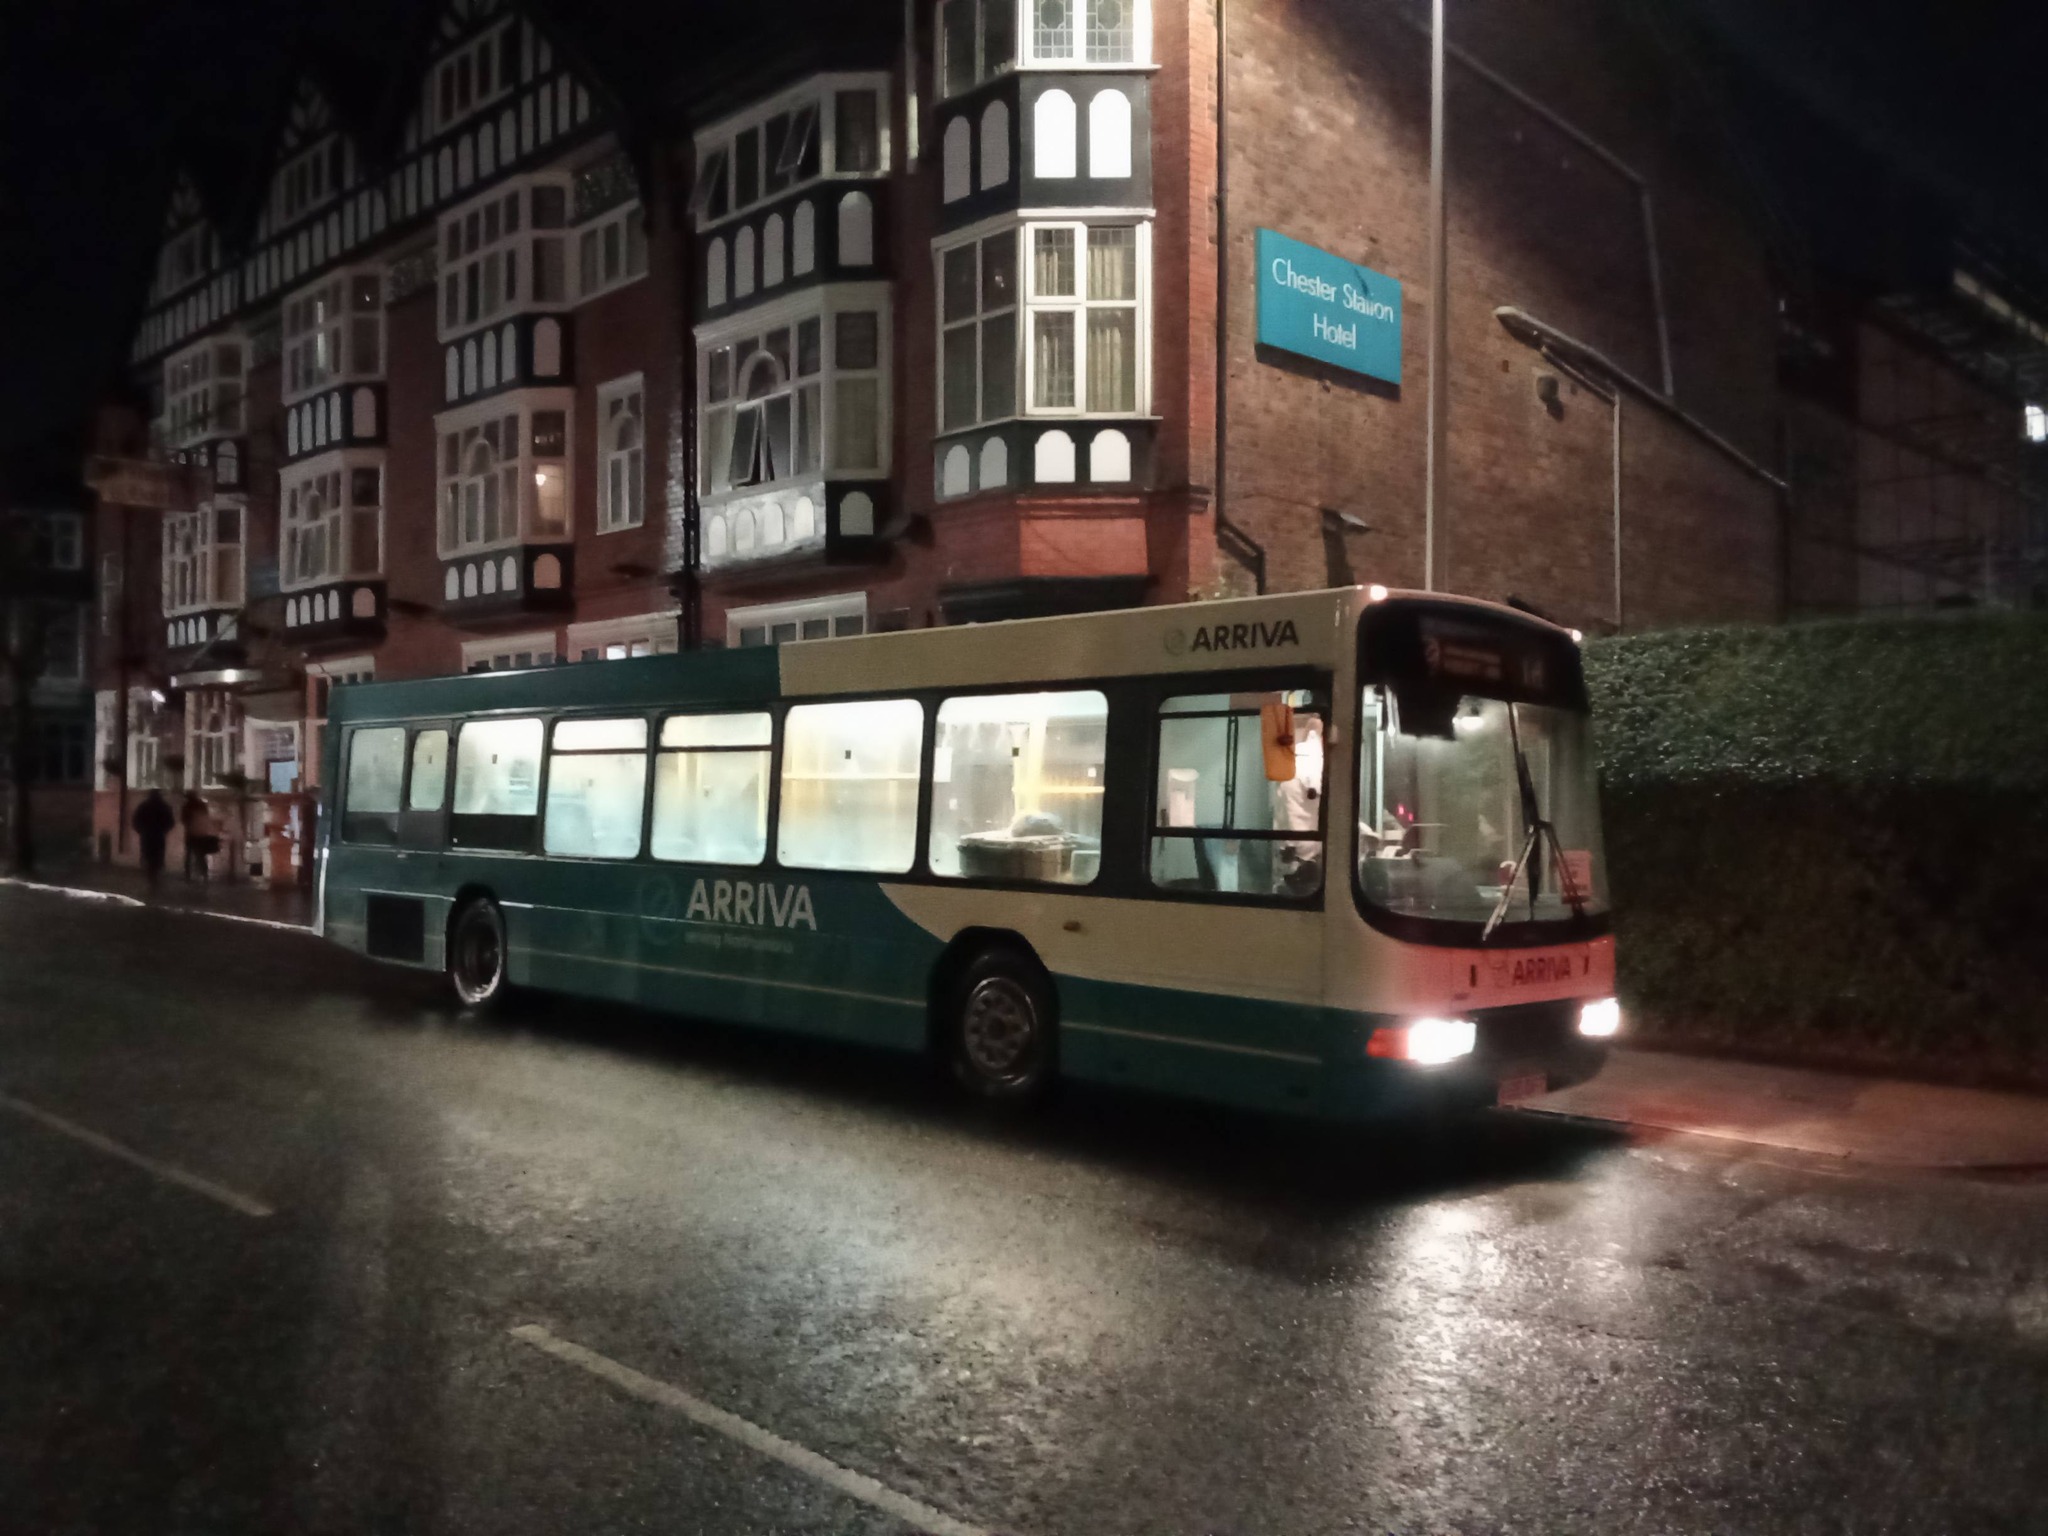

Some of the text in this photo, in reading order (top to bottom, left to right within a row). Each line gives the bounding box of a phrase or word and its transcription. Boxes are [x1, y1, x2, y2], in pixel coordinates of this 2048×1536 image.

[1272, 258, 1394, 323] Chester Station
[1313, 312, 1357, 350] Hotel
[1191, 620, 1300, 652] ARRIVA
[685, 878, 817, 931] ARRIVA
[1512, 955, 1571, 986] ARRIVA
